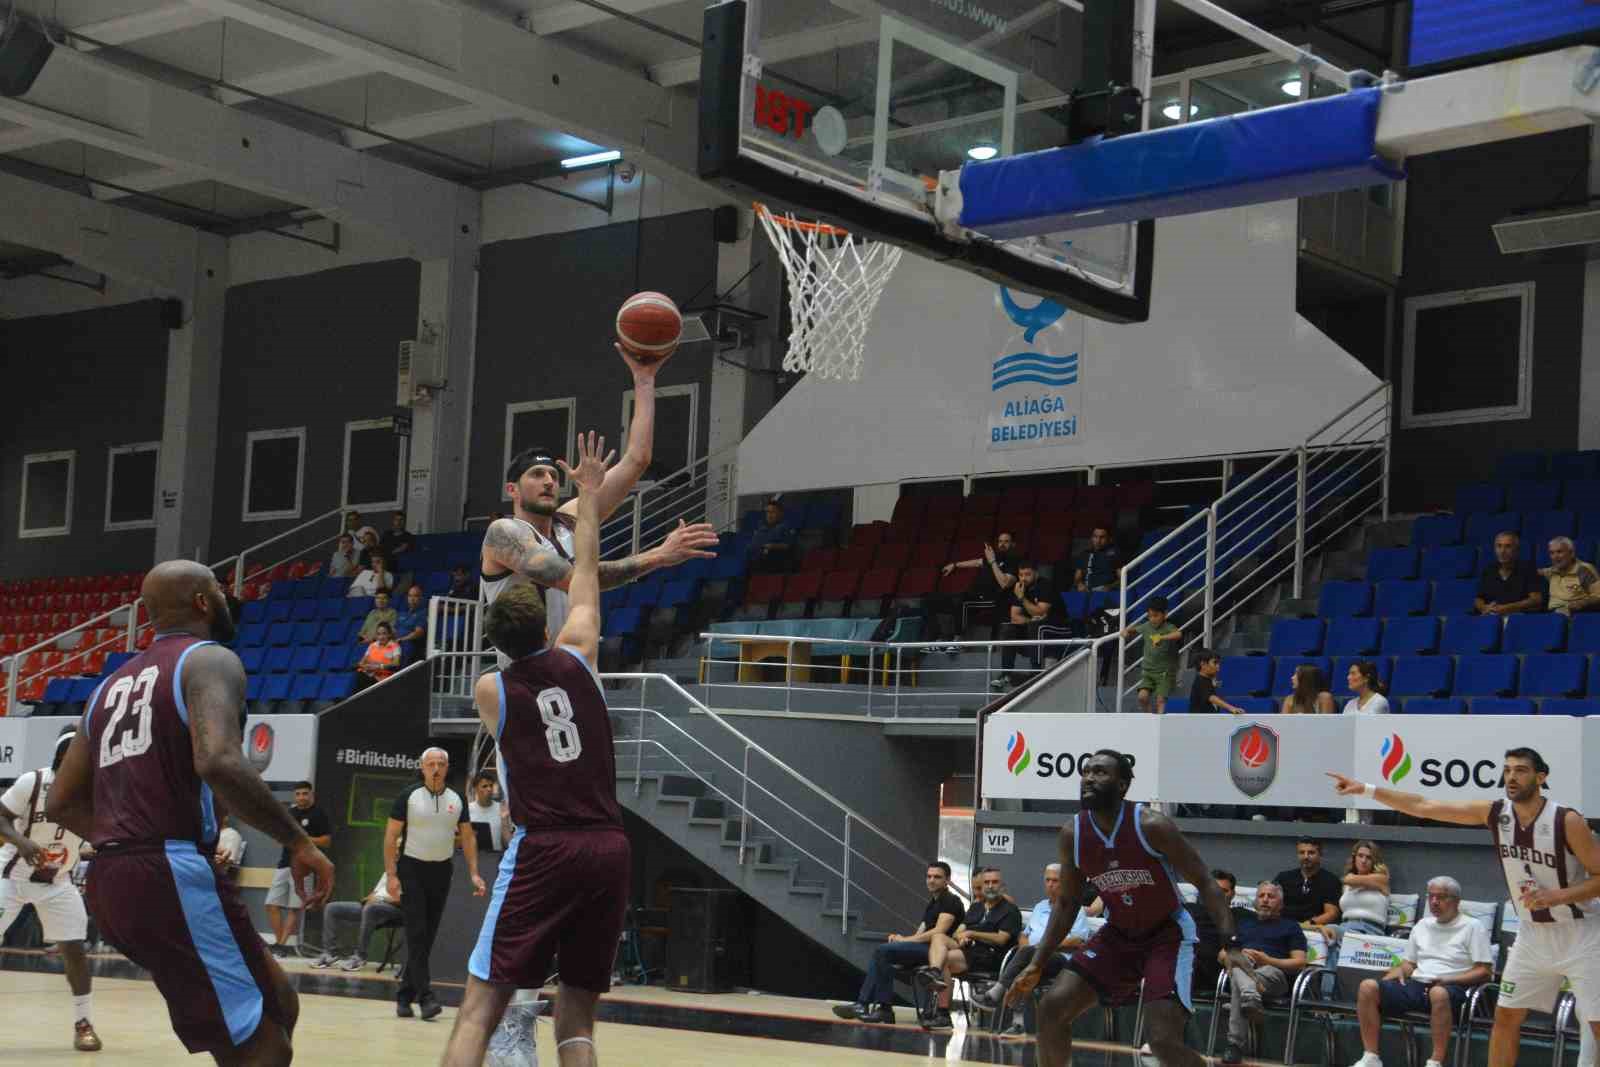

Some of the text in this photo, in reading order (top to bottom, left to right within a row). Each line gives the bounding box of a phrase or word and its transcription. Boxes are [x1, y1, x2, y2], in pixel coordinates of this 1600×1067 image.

[1004, 394, 1064, 417] ALİAĞA
[992, 415, 1076, 442] BELEDİYESİ
[99, 664, 160, 769] 23
[536, 686, 582, 763] 8
[988, 835, 1010, 847] VIP
[1500, 844, 1556, 870] BORDO
